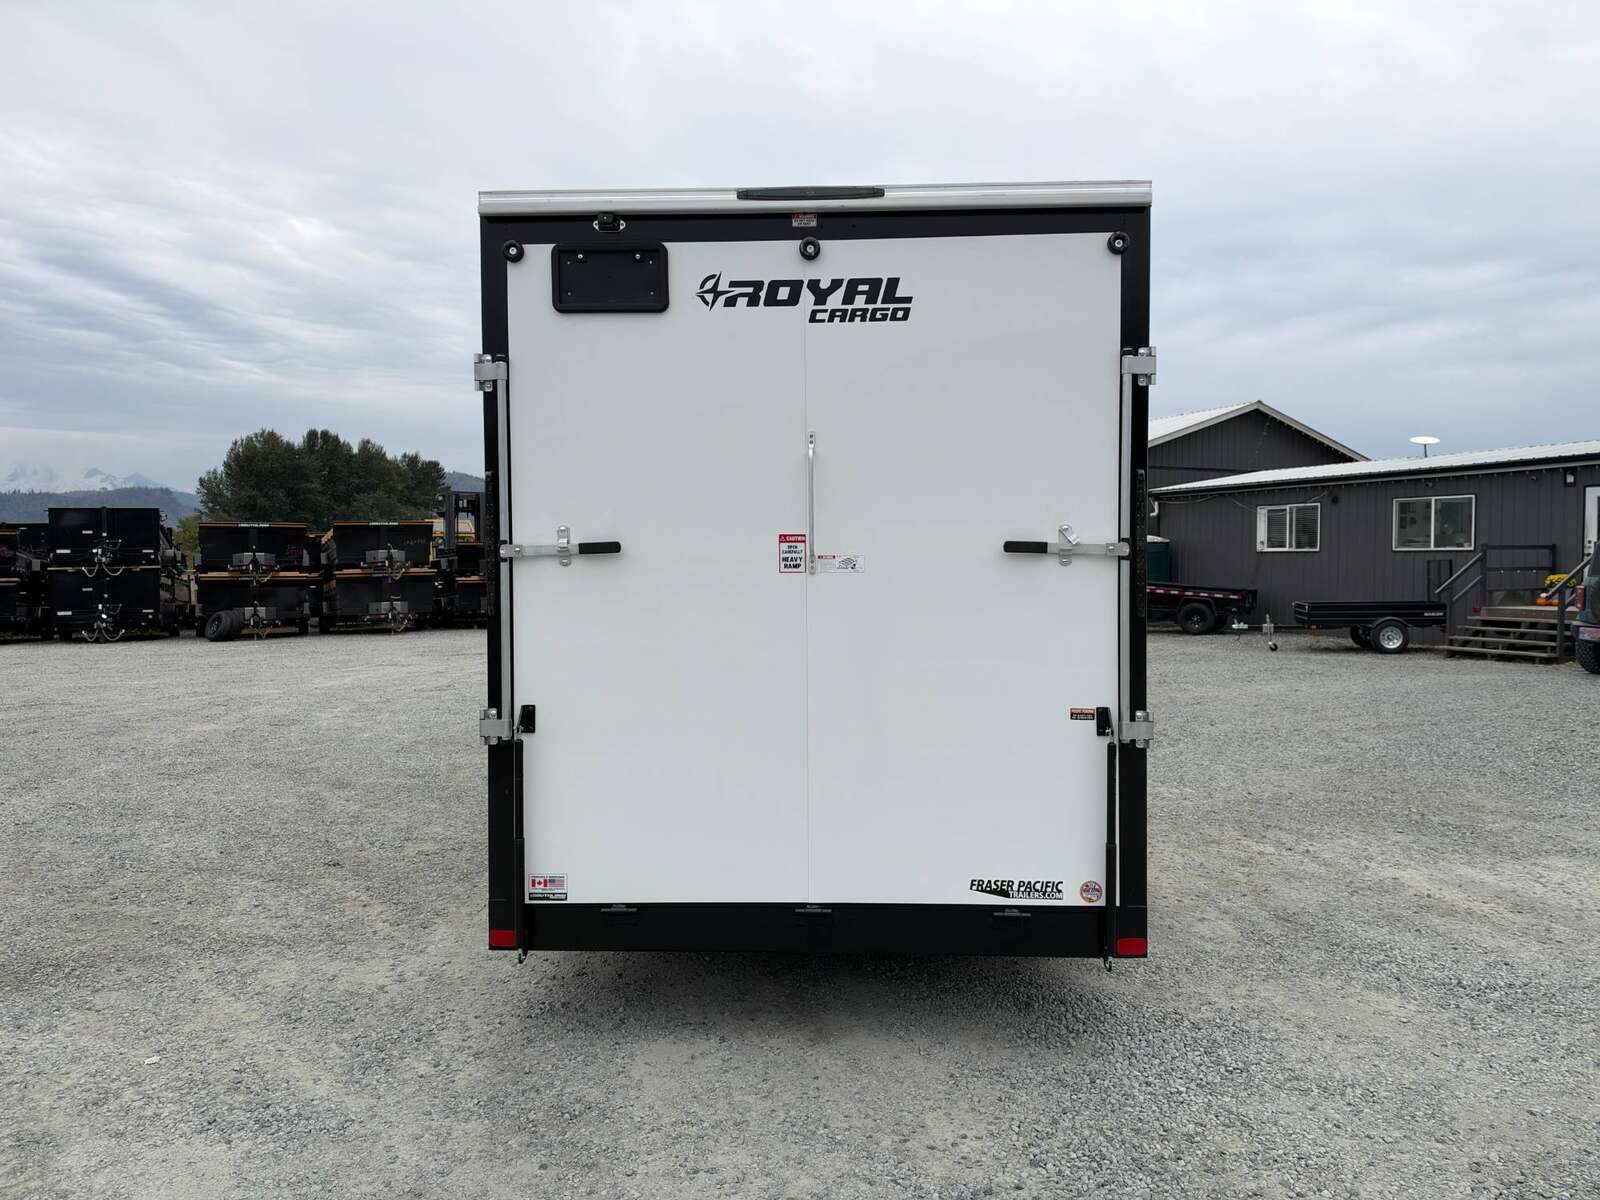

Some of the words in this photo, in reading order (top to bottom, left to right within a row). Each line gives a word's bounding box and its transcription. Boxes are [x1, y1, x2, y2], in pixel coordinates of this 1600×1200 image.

[723, 277, 913, 307] ROYAL
[808, 307, 911, 323] CARGO
[969, 879, 1014, 891] FRASER
[1017, 880, 1063, 892] PACIFIC
[1009, 891, 1063, 899] TRAILERS.COM
